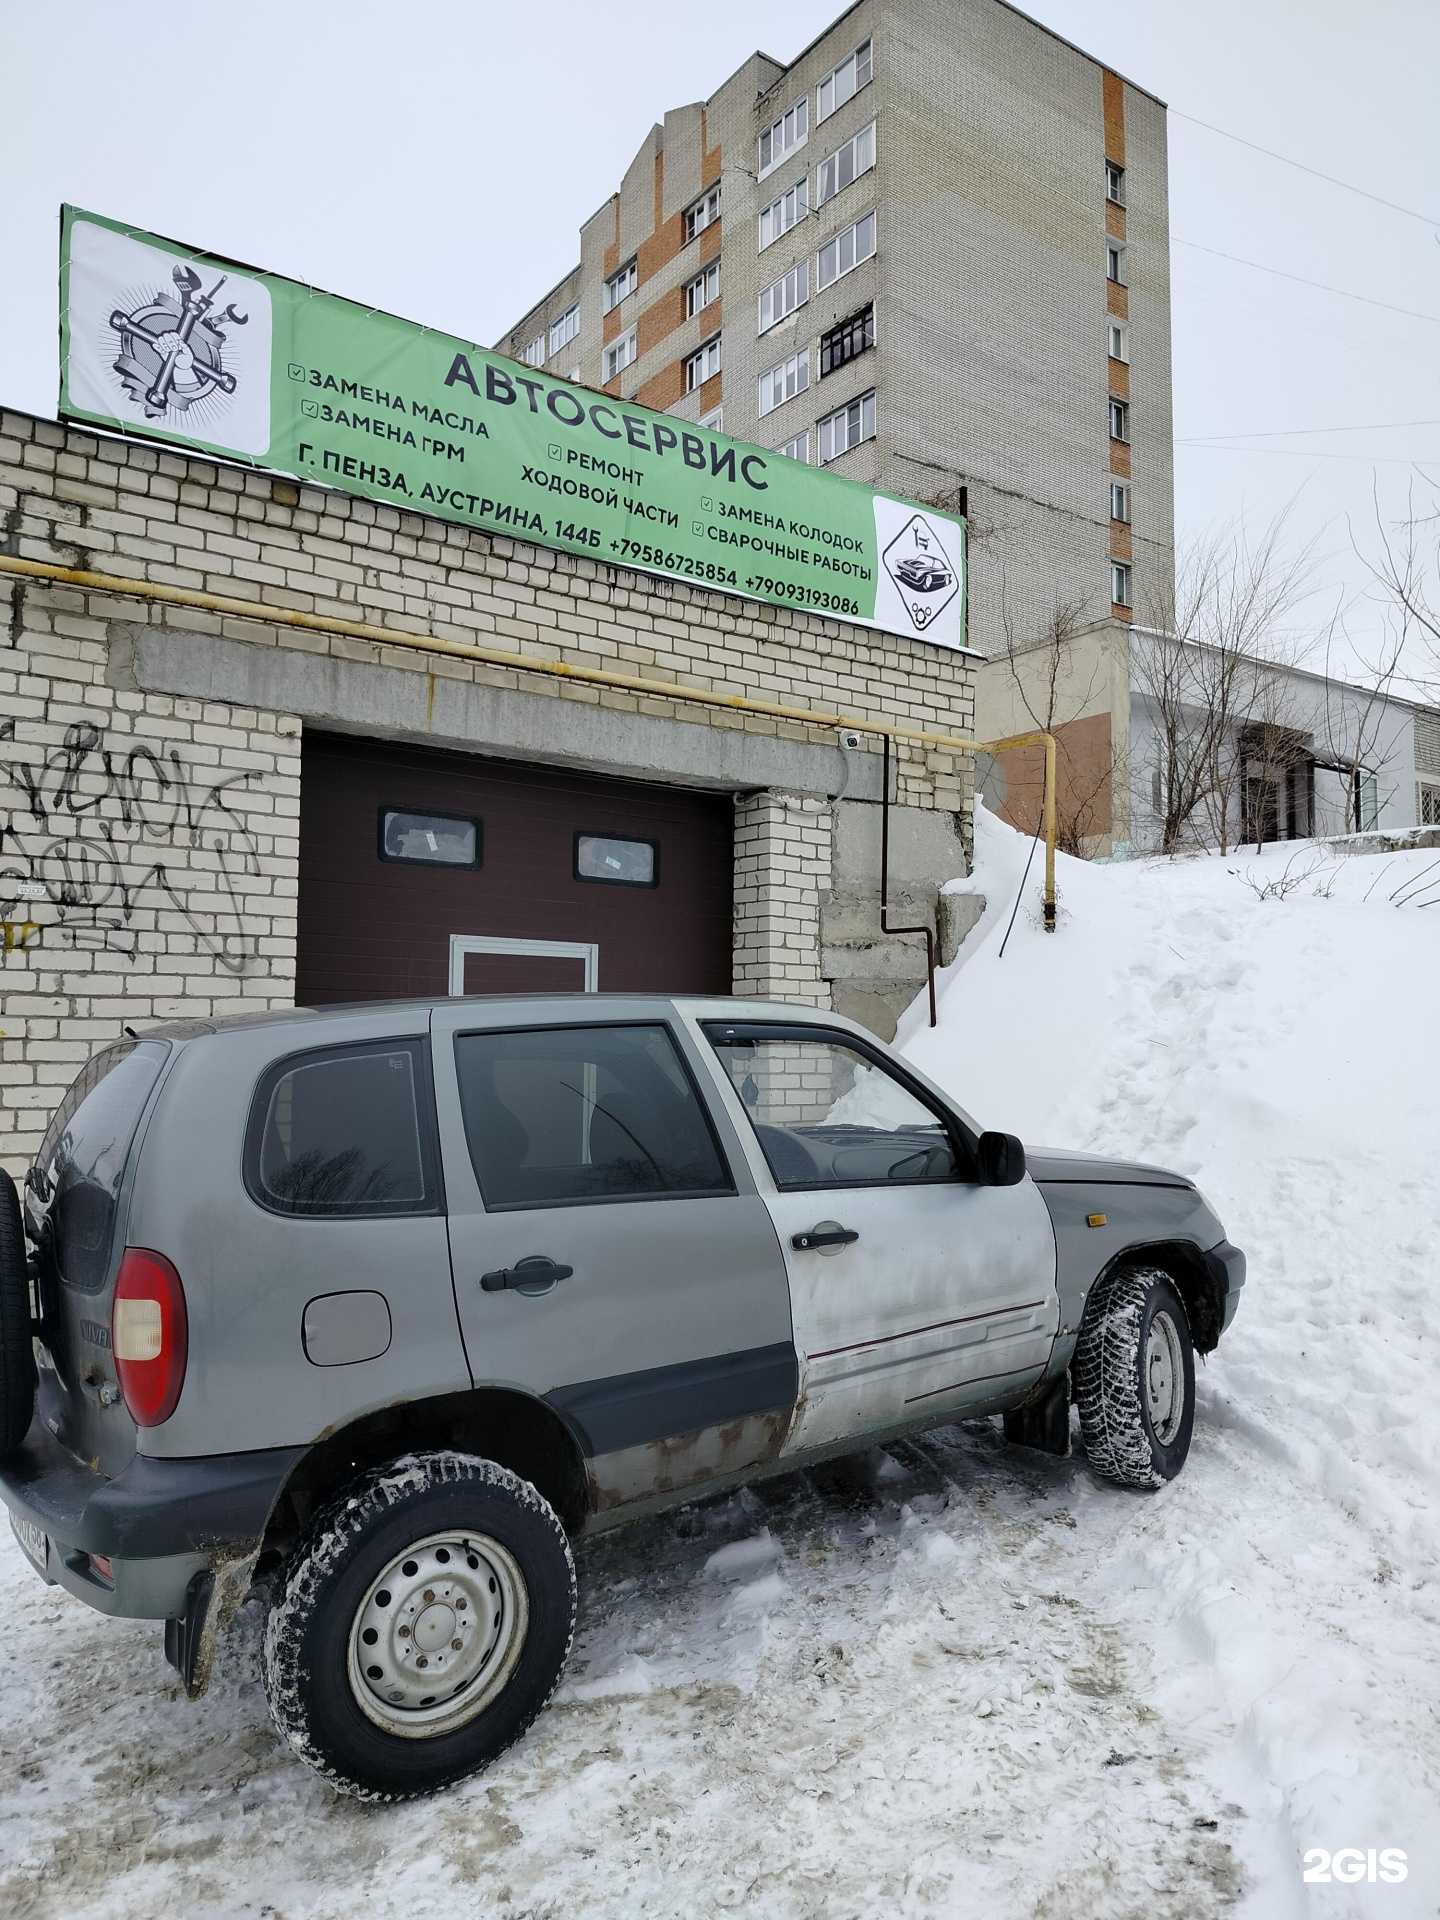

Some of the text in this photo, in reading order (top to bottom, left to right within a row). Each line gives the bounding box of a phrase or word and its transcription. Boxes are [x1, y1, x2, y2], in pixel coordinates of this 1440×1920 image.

[309, 369, 490, 439] ЗАМЕНА МАСЛА
[320, 405, 465, 462] ЗАМЕНА ГРМ
[443, 353, 769, 490] АВТОСЕРВИС
[521, 464, 679, 528] ХОДОВОЙ ЧАСТИ
[567, 449, 644, 487] РЕМОНТ
[298, 443, 860, 616] Г. ПЕНЗА, АУСТРИНА, 144Б +79586725854 +79093193086
[707, 525, 872, 581] СВАРОЧНЫЕ РАБОТЫ
[718, 502, 864, 554] ЗАМЕНА КОЛОДОК
